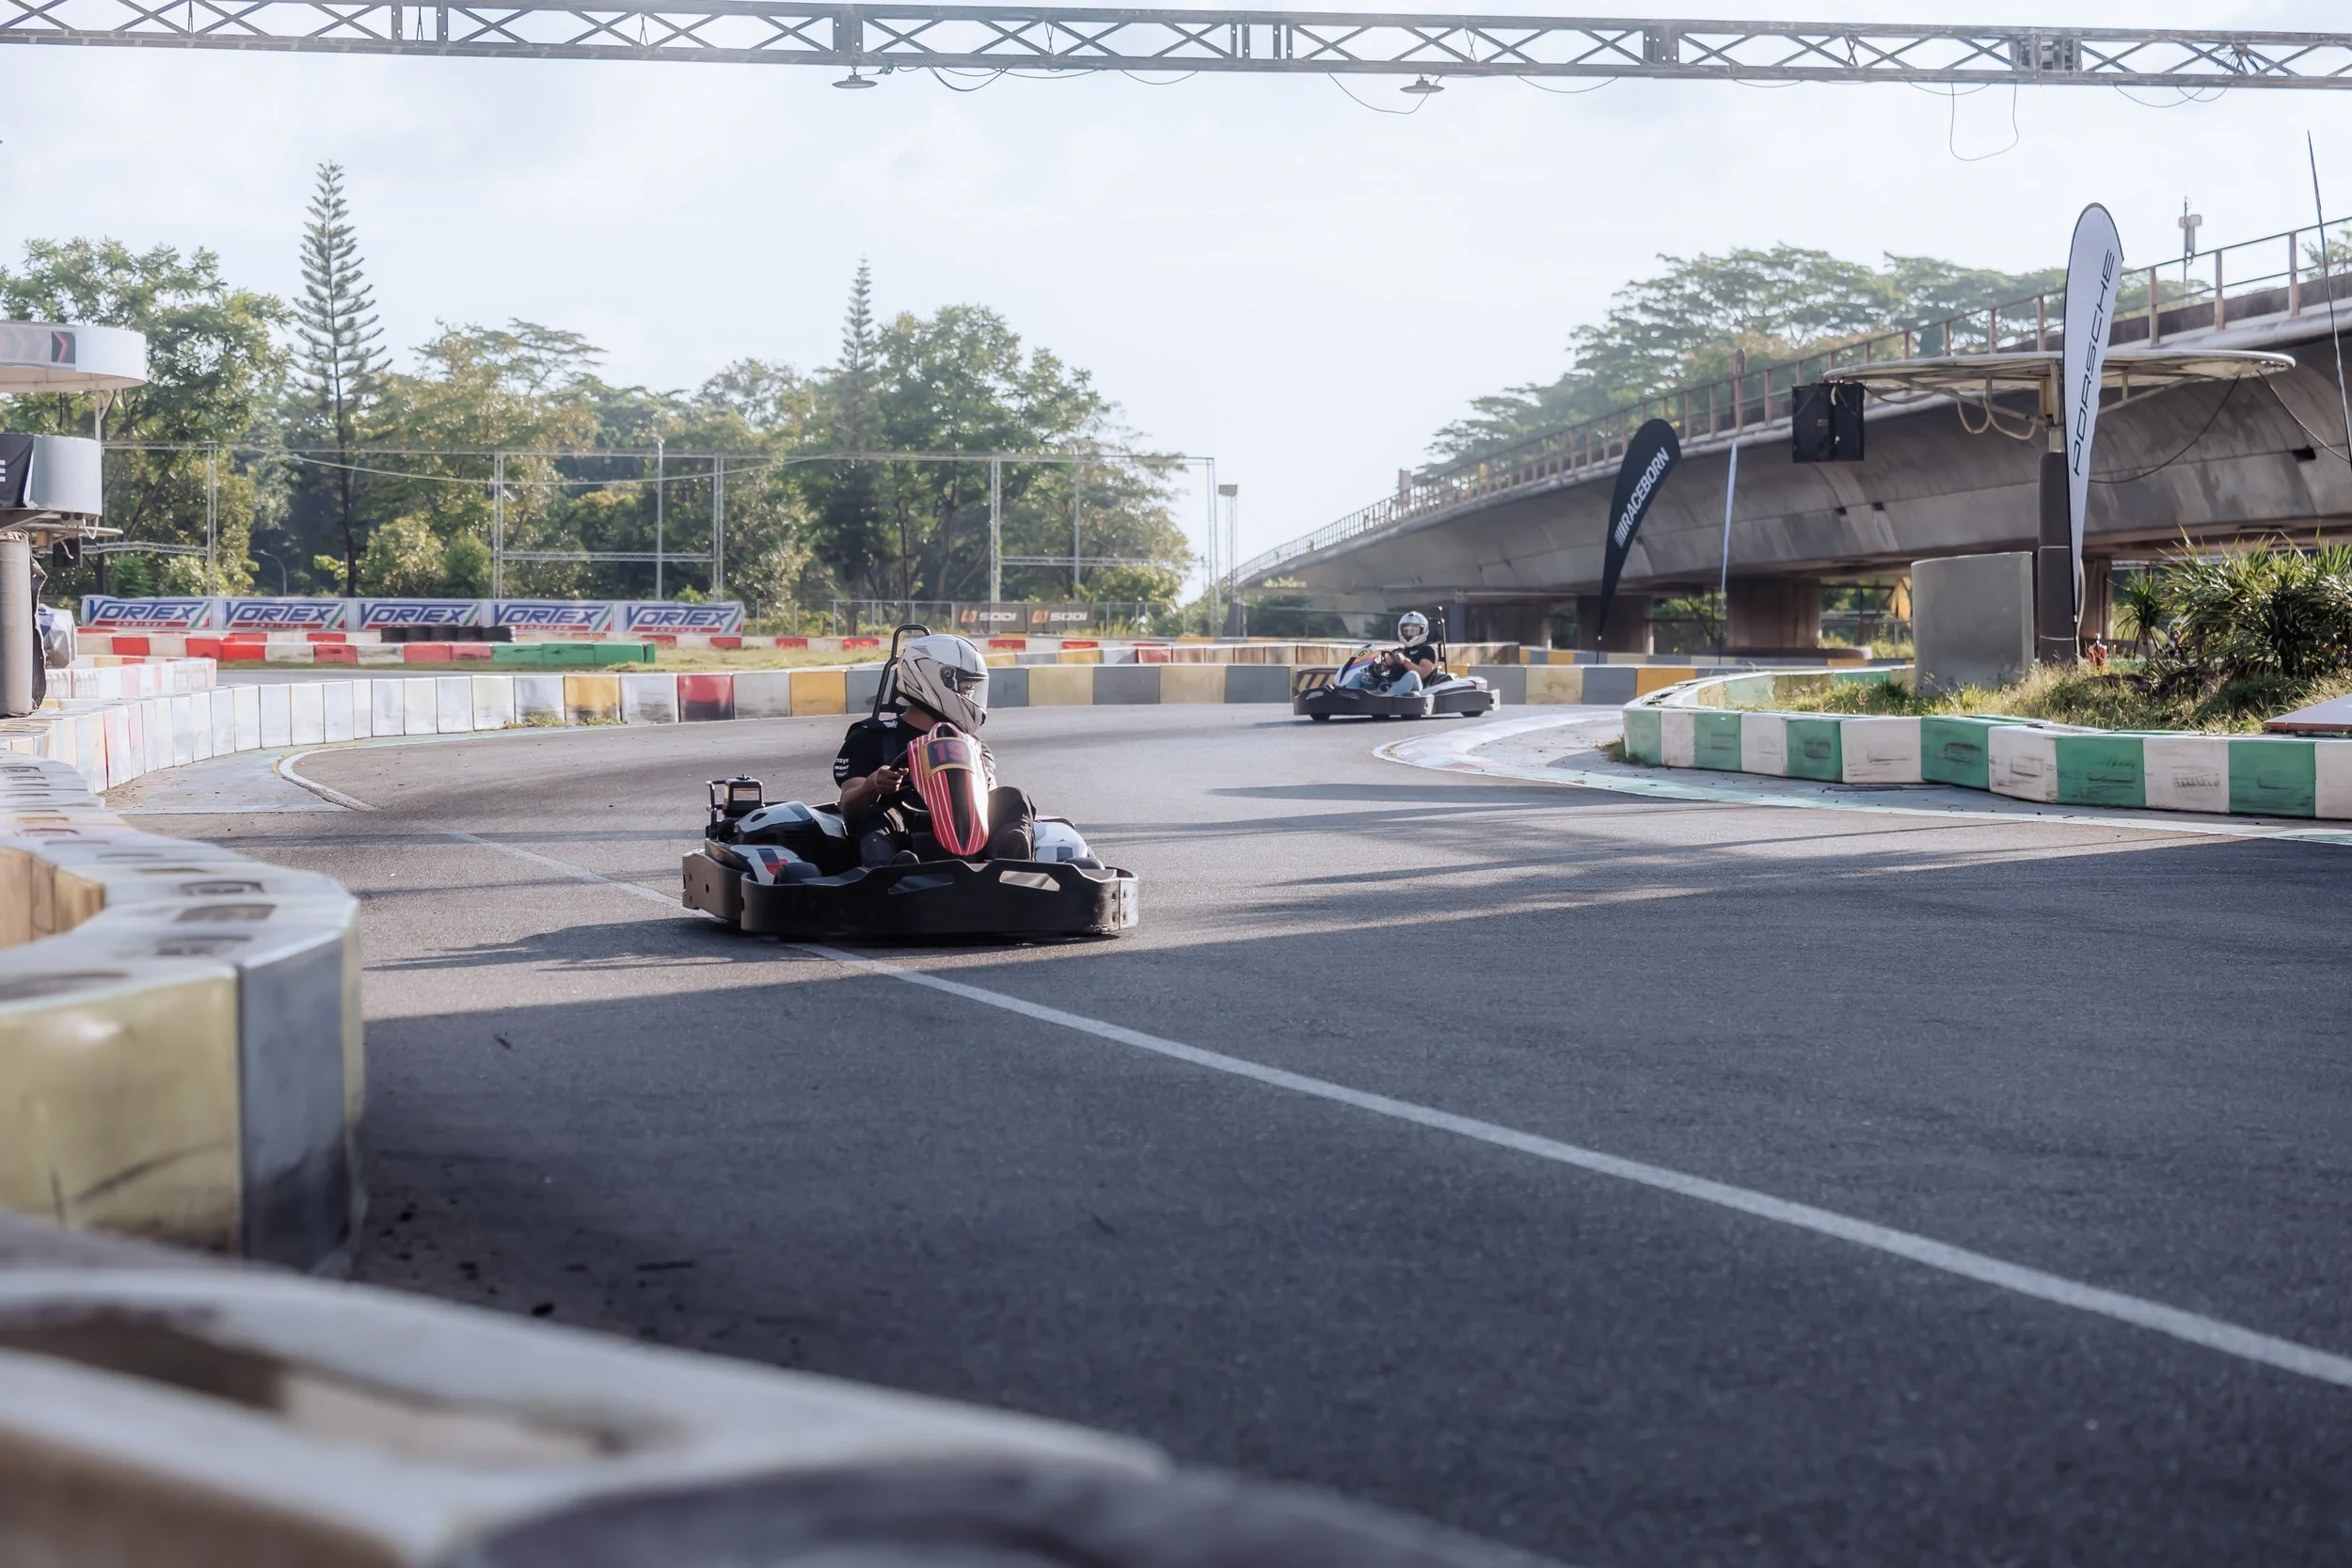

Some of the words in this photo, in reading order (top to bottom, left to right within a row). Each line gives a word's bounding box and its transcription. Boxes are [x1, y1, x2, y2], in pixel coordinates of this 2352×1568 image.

[2073, 248, 2115, 476] PORSCHE
[1620, 447, 1670, 534] RACEBORN
[89, 599, 204, 622] VORTEX
[226, 601, 340, 625] VORTEX
[360, 603, 473, 626] VORTEX
[494, 604, 605, 626] VORTEX
[627, 606, 735, 630] VORTEX
[978, 612, 1017, 622] SODI
[1050, 612, 1088, 622] SODI
